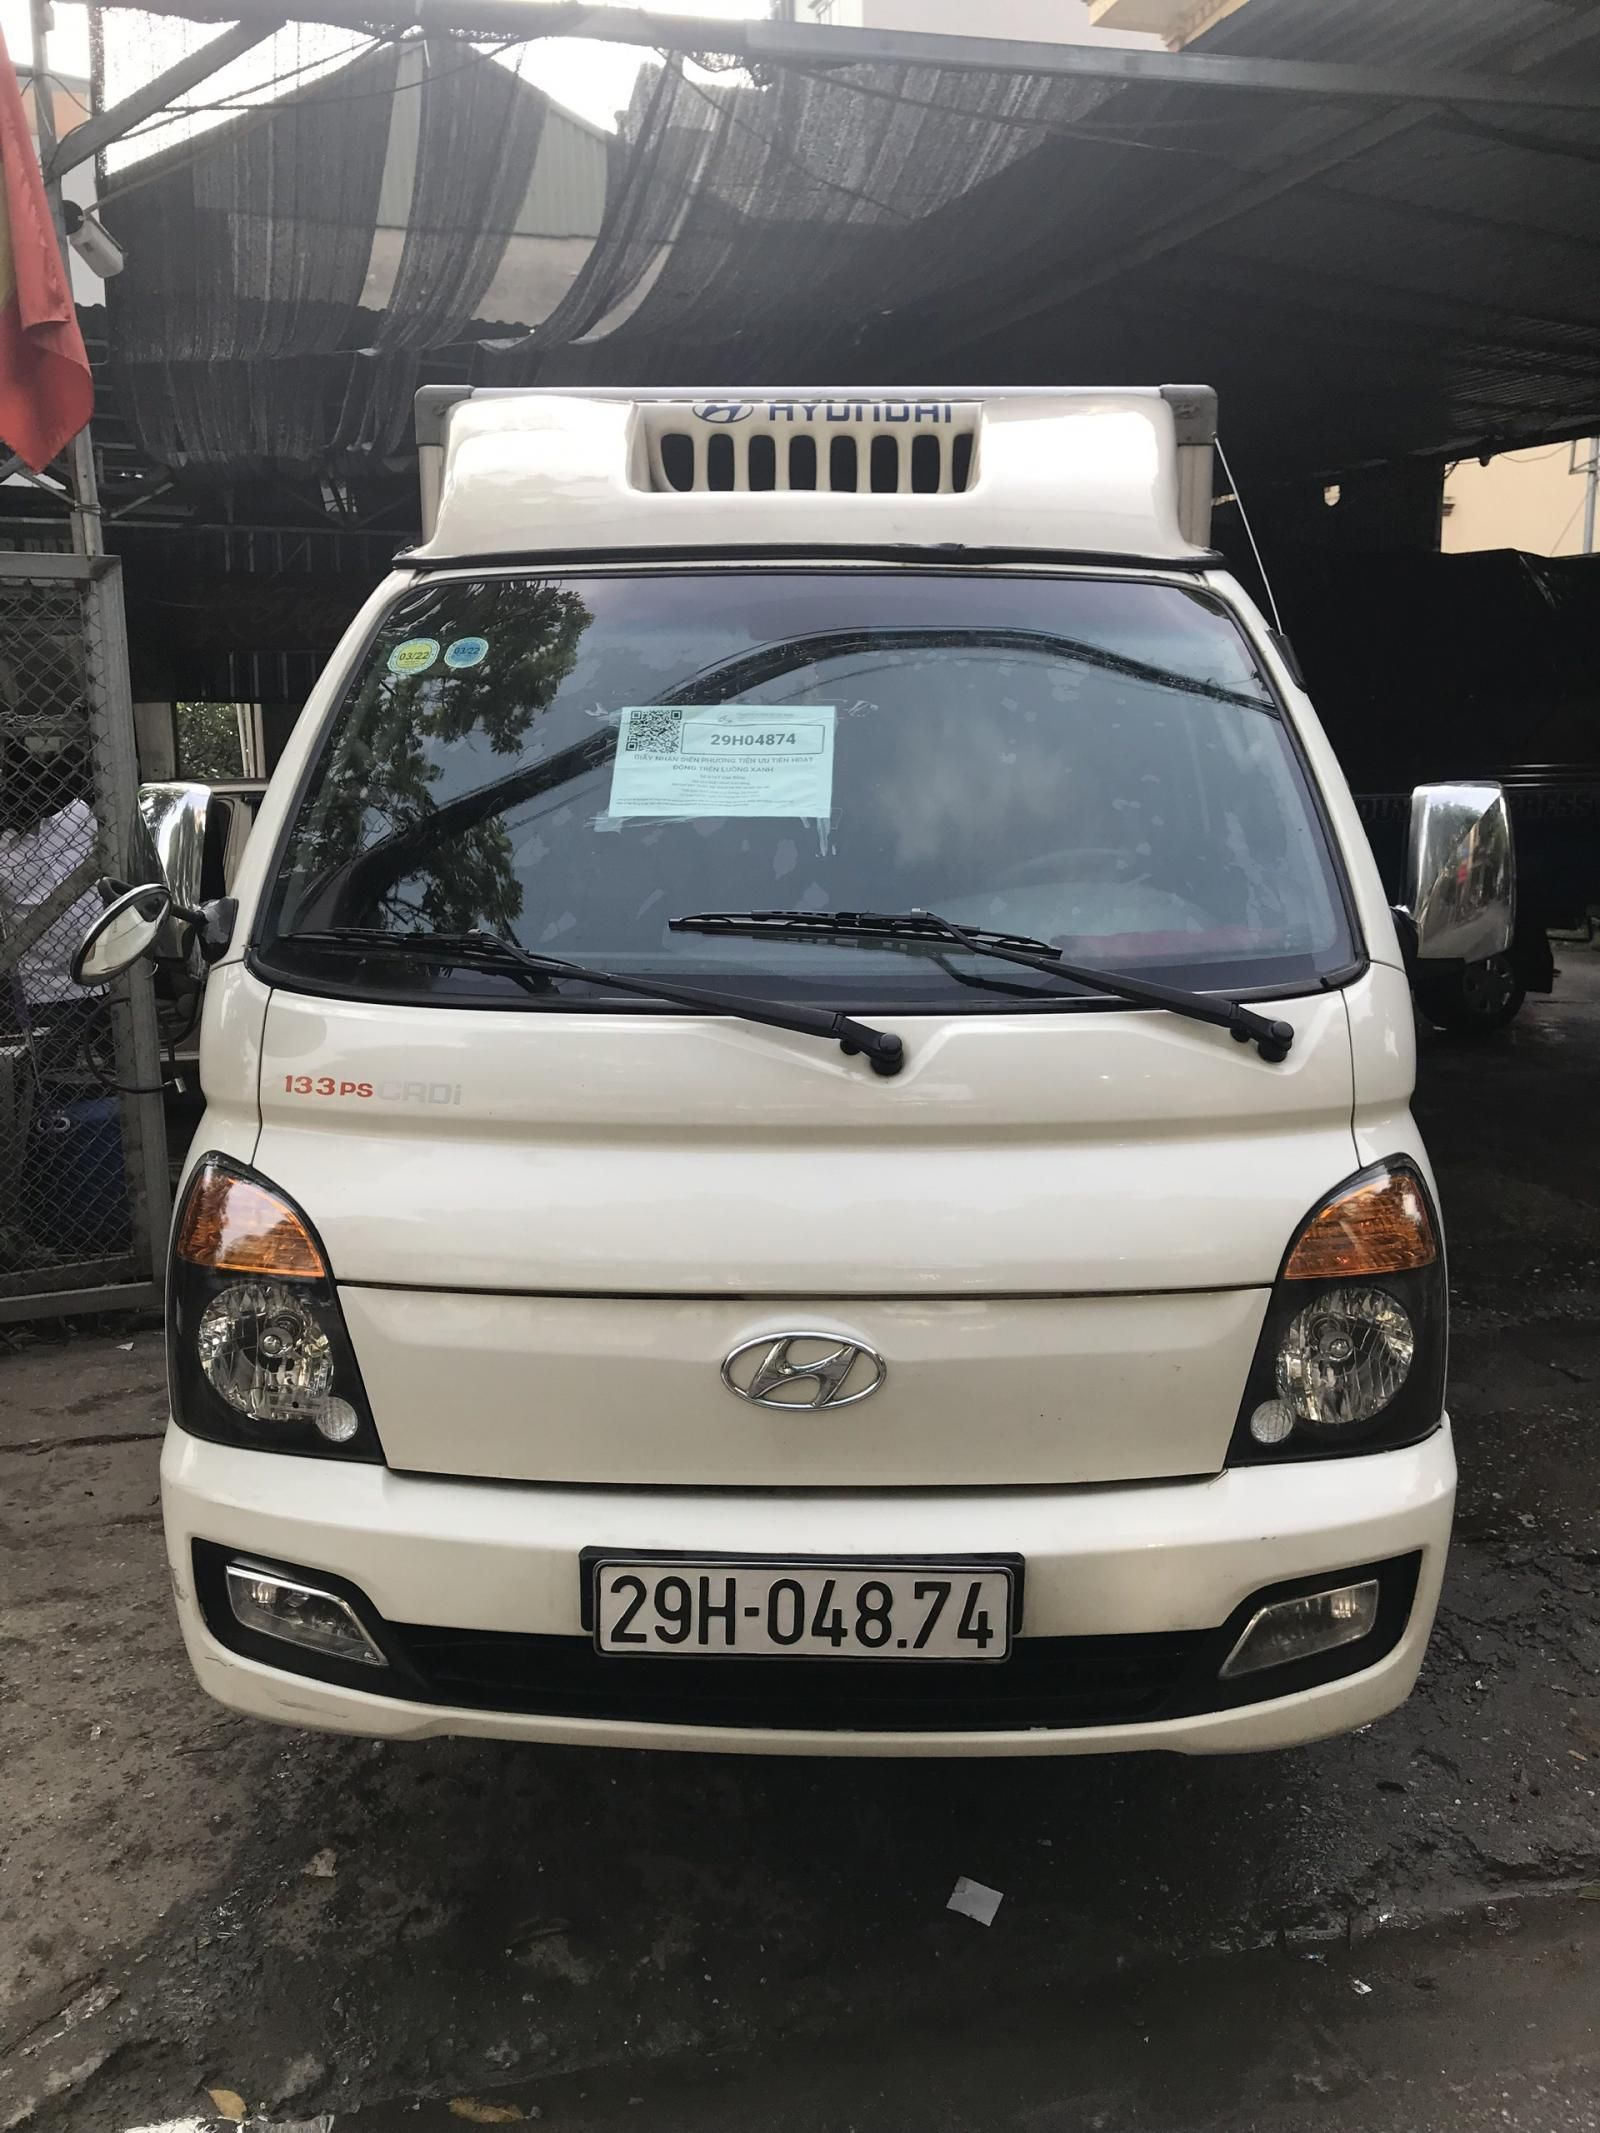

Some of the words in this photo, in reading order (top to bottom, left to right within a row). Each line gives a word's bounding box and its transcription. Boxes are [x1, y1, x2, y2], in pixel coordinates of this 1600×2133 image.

[768, 403, 952, 423] HYUNDAI
[399, 651, 430, 661] 03/22
[453, 647, 480, 656] 03/22
[710, 733, 797, 746] 29H04874
[609, 1574, 994, 1649] 29H-048.74
